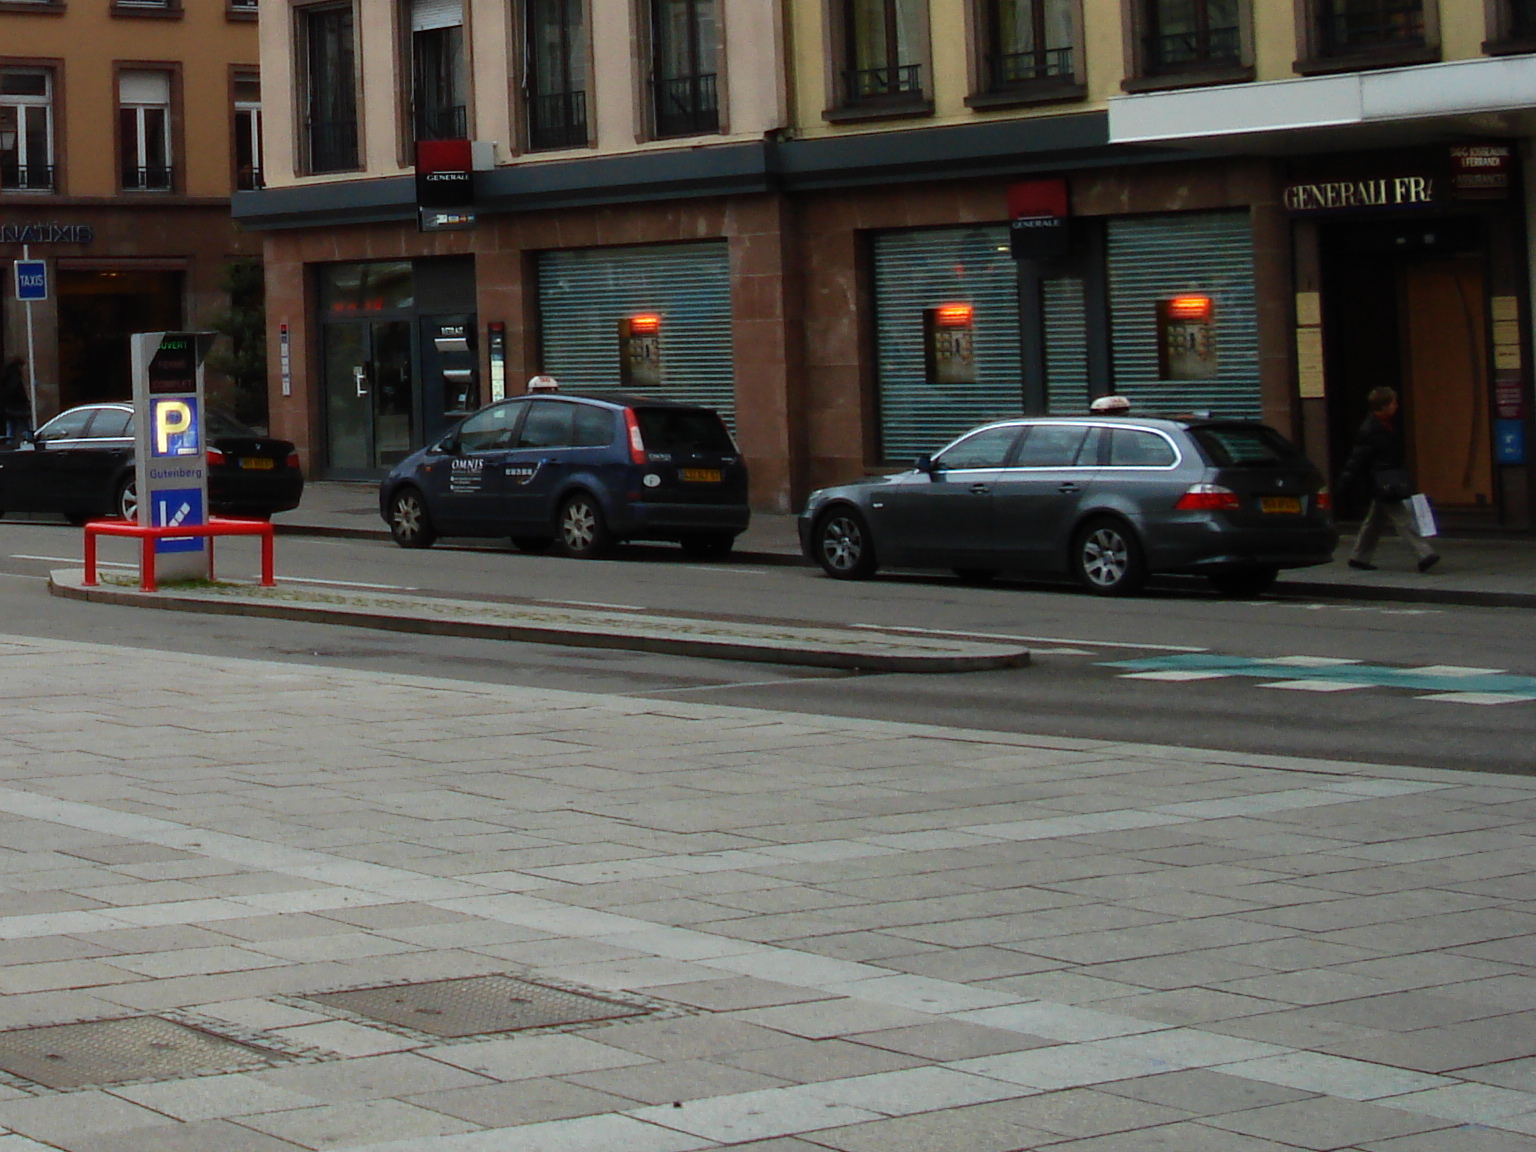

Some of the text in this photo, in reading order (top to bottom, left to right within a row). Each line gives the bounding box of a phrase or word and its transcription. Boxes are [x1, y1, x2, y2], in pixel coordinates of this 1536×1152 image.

[1284, 179, 1388, 210] GENERALI
[0, 224, 95, 243] NATIXIS
[20, 275, 44, 287] TAXIS
[156, 401, 191, 453] P
[452, 458, 484, 469] OMNIS
[150, 468, 202, 479] Gutenberg
